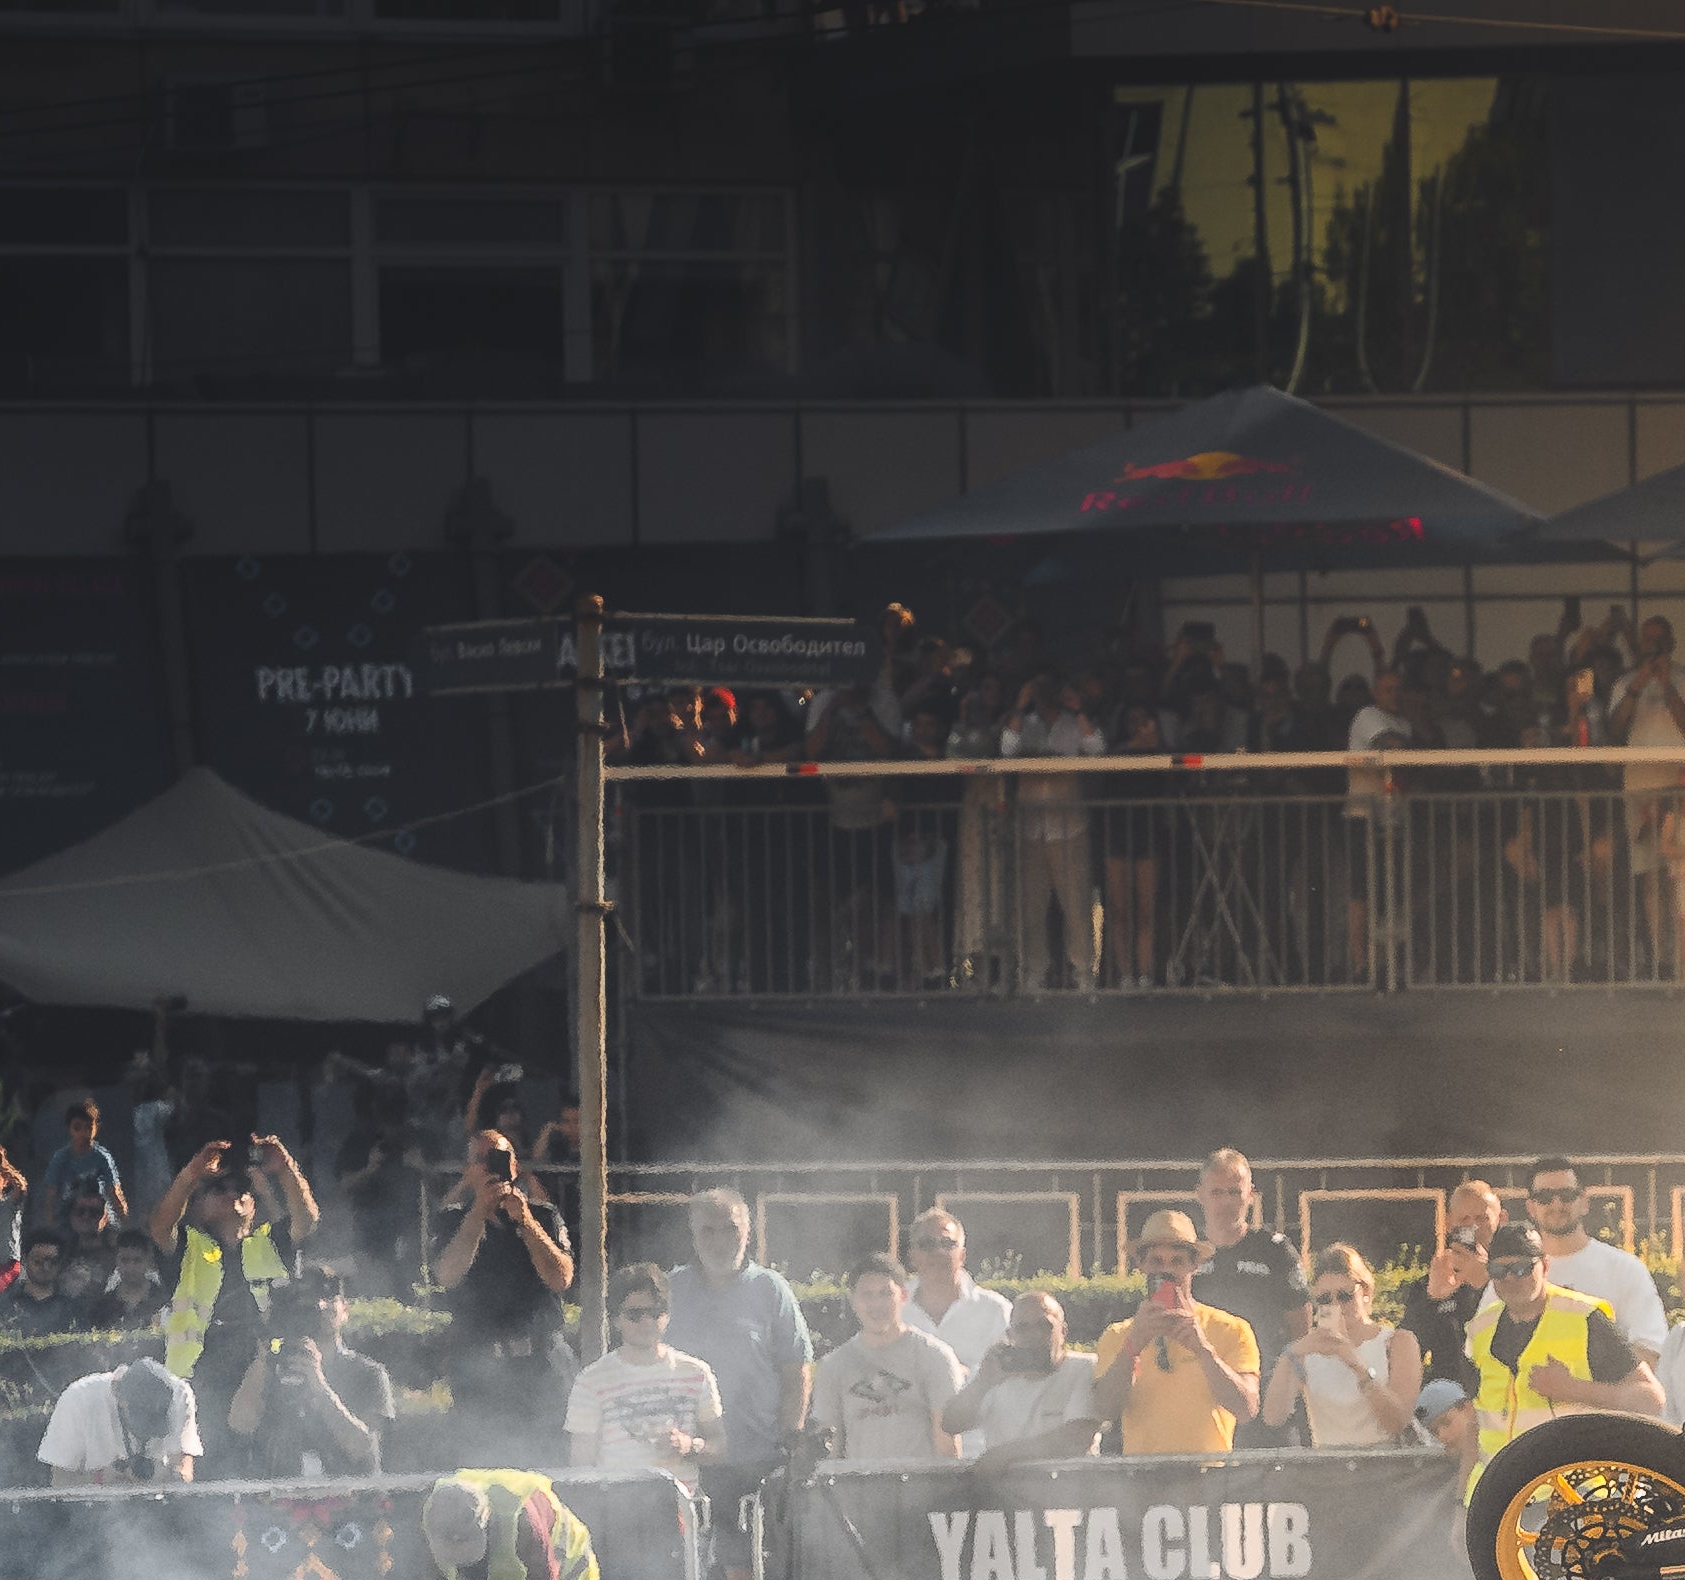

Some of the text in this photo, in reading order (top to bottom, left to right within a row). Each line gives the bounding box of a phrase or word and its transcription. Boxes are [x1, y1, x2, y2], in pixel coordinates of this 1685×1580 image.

[686, 632, 727, 658] Цар
[732, 633, 867, 658] Освободител
[253, 663, 414, 703] PRE-PARTY
